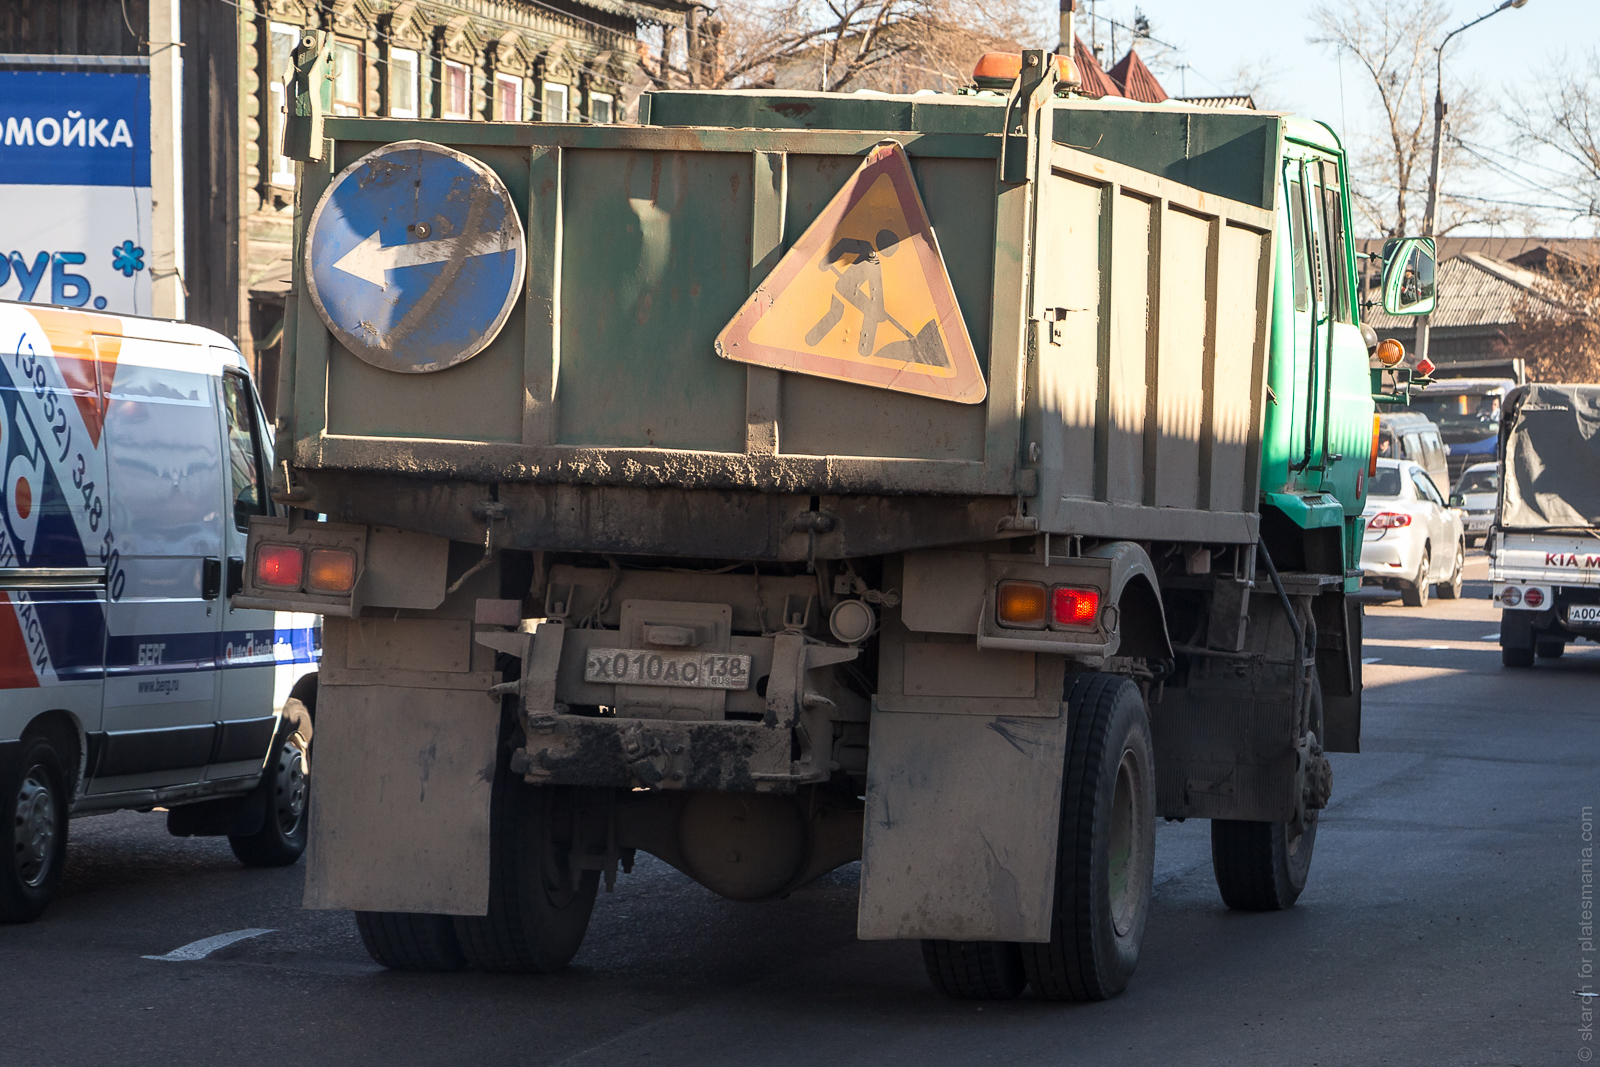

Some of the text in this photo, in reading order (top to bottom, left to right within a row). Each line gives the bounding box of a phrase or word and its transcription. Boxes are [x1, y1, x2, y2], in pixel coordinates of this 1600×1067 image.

[0, 110, 134, 148] МОЙКА
[15, 332, 71, 463] (3952)
[73, 453, 103, 533] 348
[1545, 553, 1578, 567] KIA
[704, 656, 742, 677] 138
[711, 677, 731, 685] RUS
